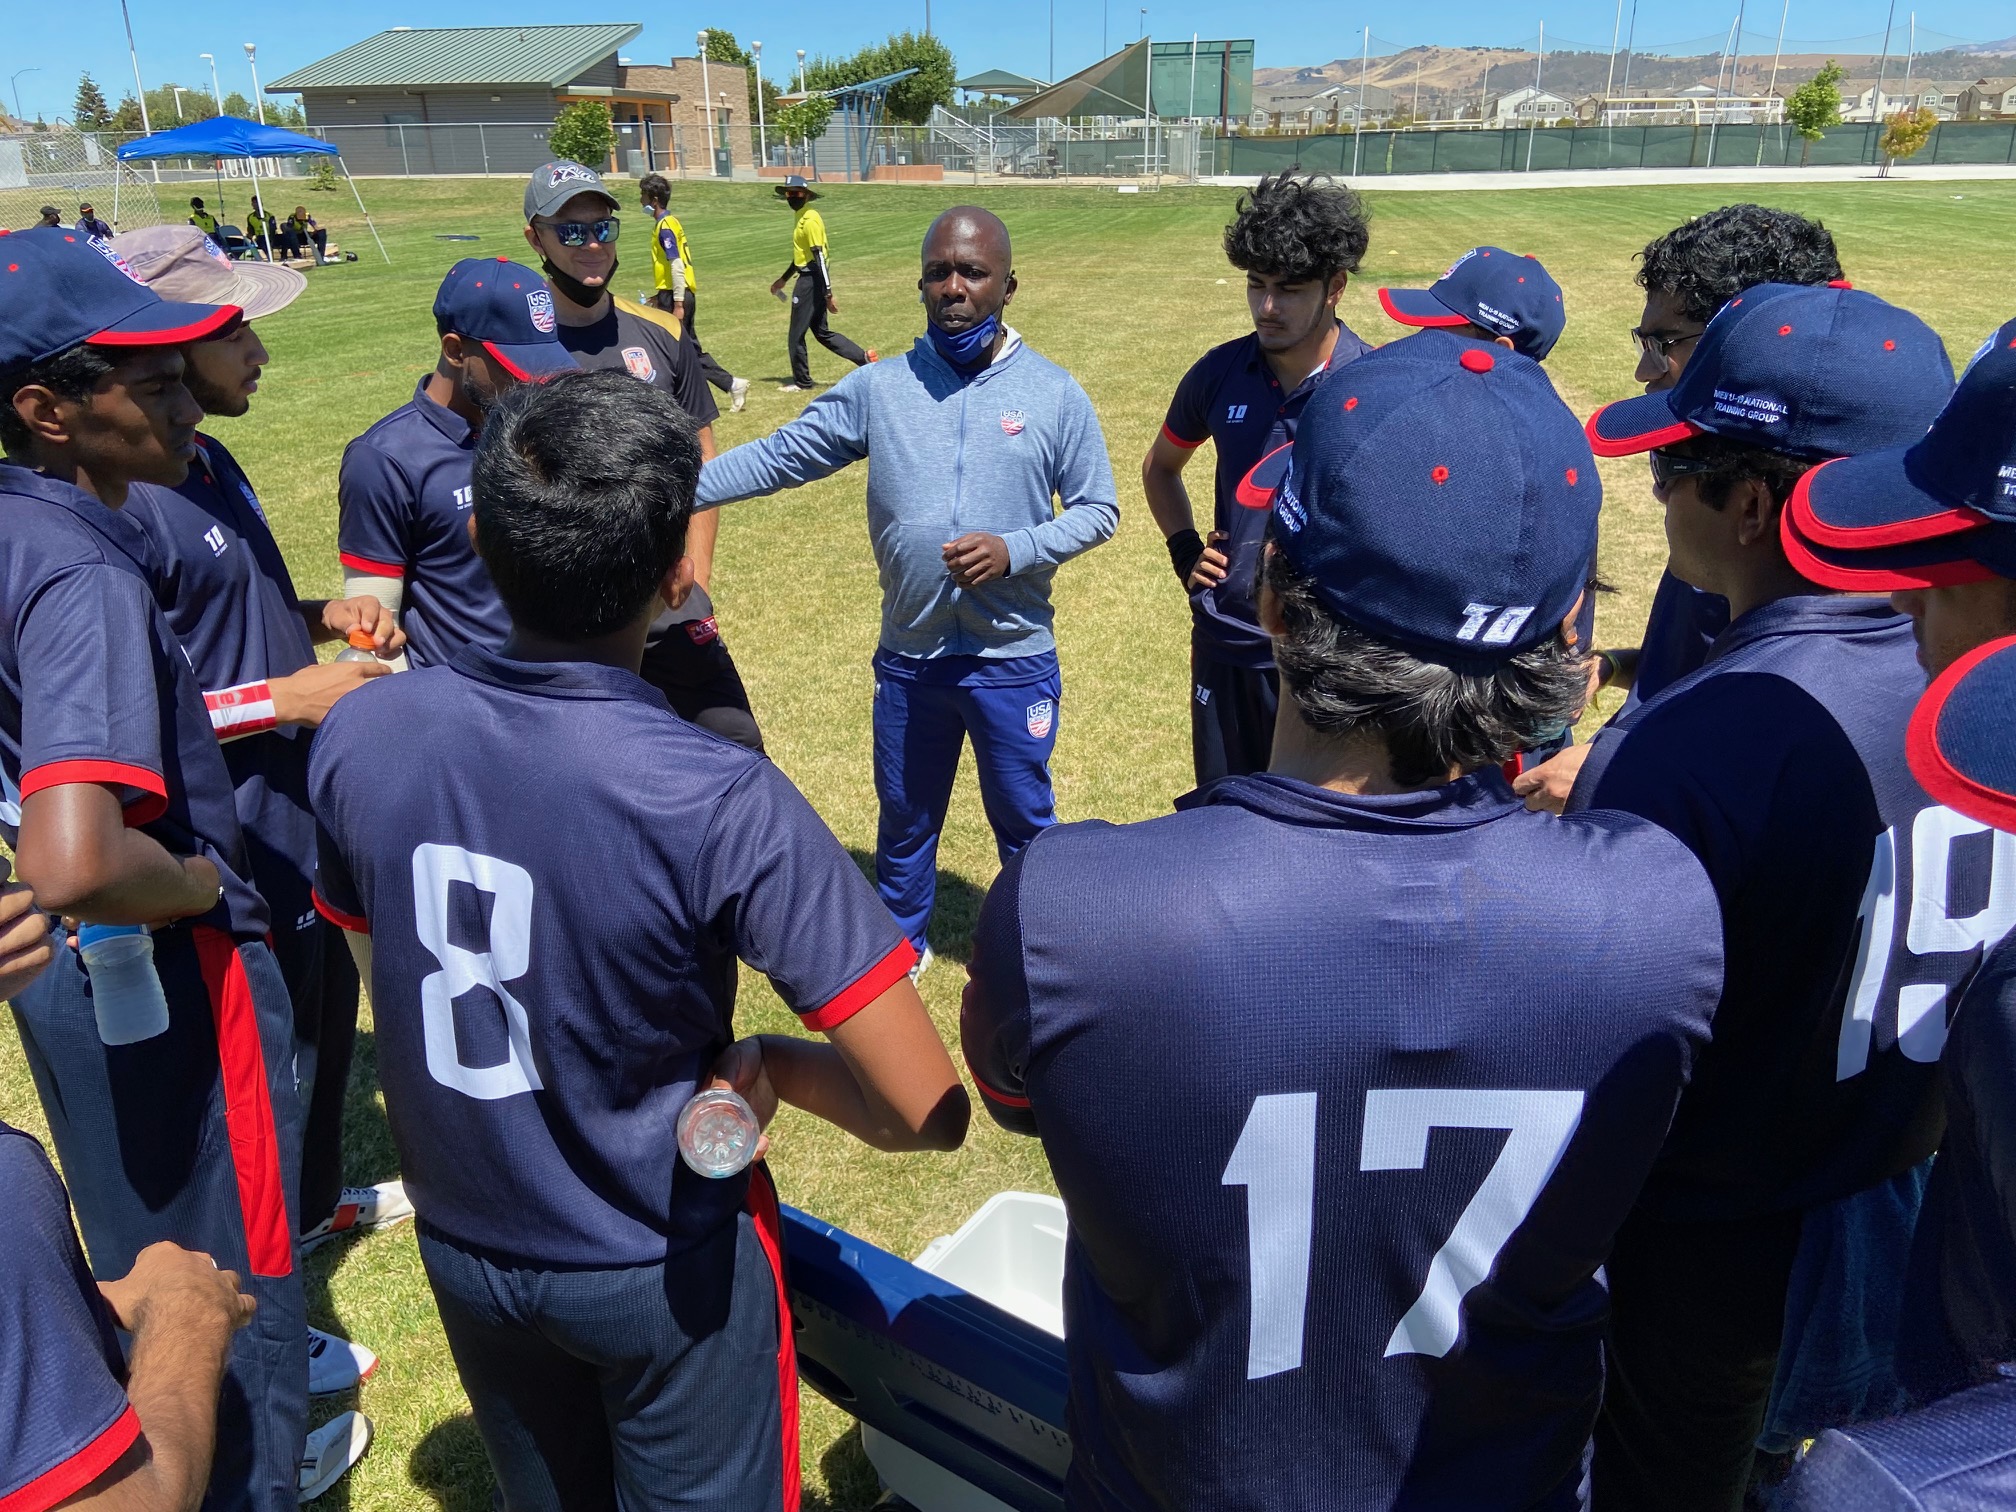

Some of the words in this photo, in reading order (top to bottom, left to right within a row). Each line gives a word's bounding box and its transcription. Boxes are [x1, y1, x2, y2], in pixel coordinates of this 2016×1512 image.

[530, 293, 551, 306] USA
[1001, 409, 1023, 419] USA
[1713, 389, 1729, 401] MEN
[1743, 397, 1788, 415] NATIONAL
[1714, 402, 1746, 417] TRAINING
[1748, 411, 1780, 424] GROUP
[1029, 702, 1051, 717] USA
[1836, 805, 2016, 1083] 19
[412, 842, 545, 1101] 8
[1221, 1088, 1585, 1380] 17
